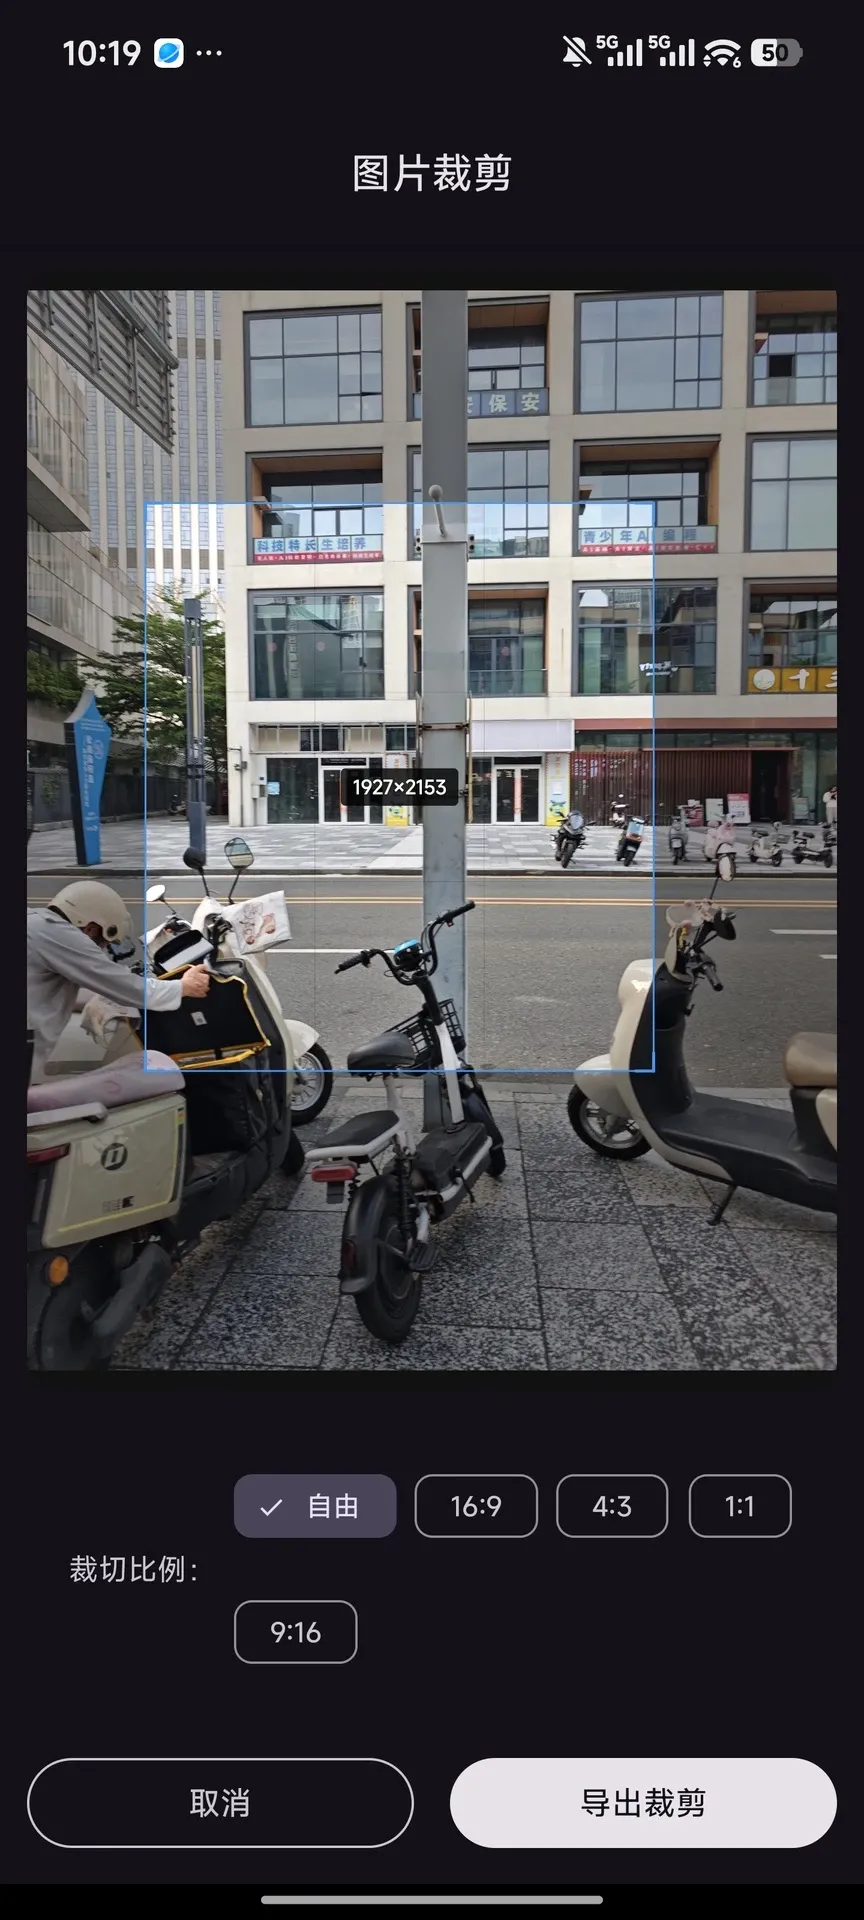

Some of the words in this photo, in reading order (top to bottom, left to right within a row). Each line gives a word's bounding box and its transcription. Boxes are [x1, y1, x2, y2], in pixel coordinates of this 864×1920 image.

[63, 39, 141, 67] 10:19
[596, 34, 619, 50] 5G
[648, 34, 671, 50] 5G
[761, 43, 789, 62] 50
[730, 54, 742, 69] 6
[353, 153, 512, 192] 图片裁剪
[256, 537, 367, 552] 科技特长生培养
[352, 778, 447, 796] 1927×2153
[308, 1492, 358, 1519] 自由
[451, 1495, 502, 1518] 16:9
[592, 1495, 632, 1518] 4:3
[725, 1495, 753, 1518] 1:1
[70, 1554, 197, 1583] 裁切比例：
[270, 1621, 321, 1644] 9:16
[189, 1787, 250, 1818] 取消
[581, 1787, 706, 1818] 导出裁剪
